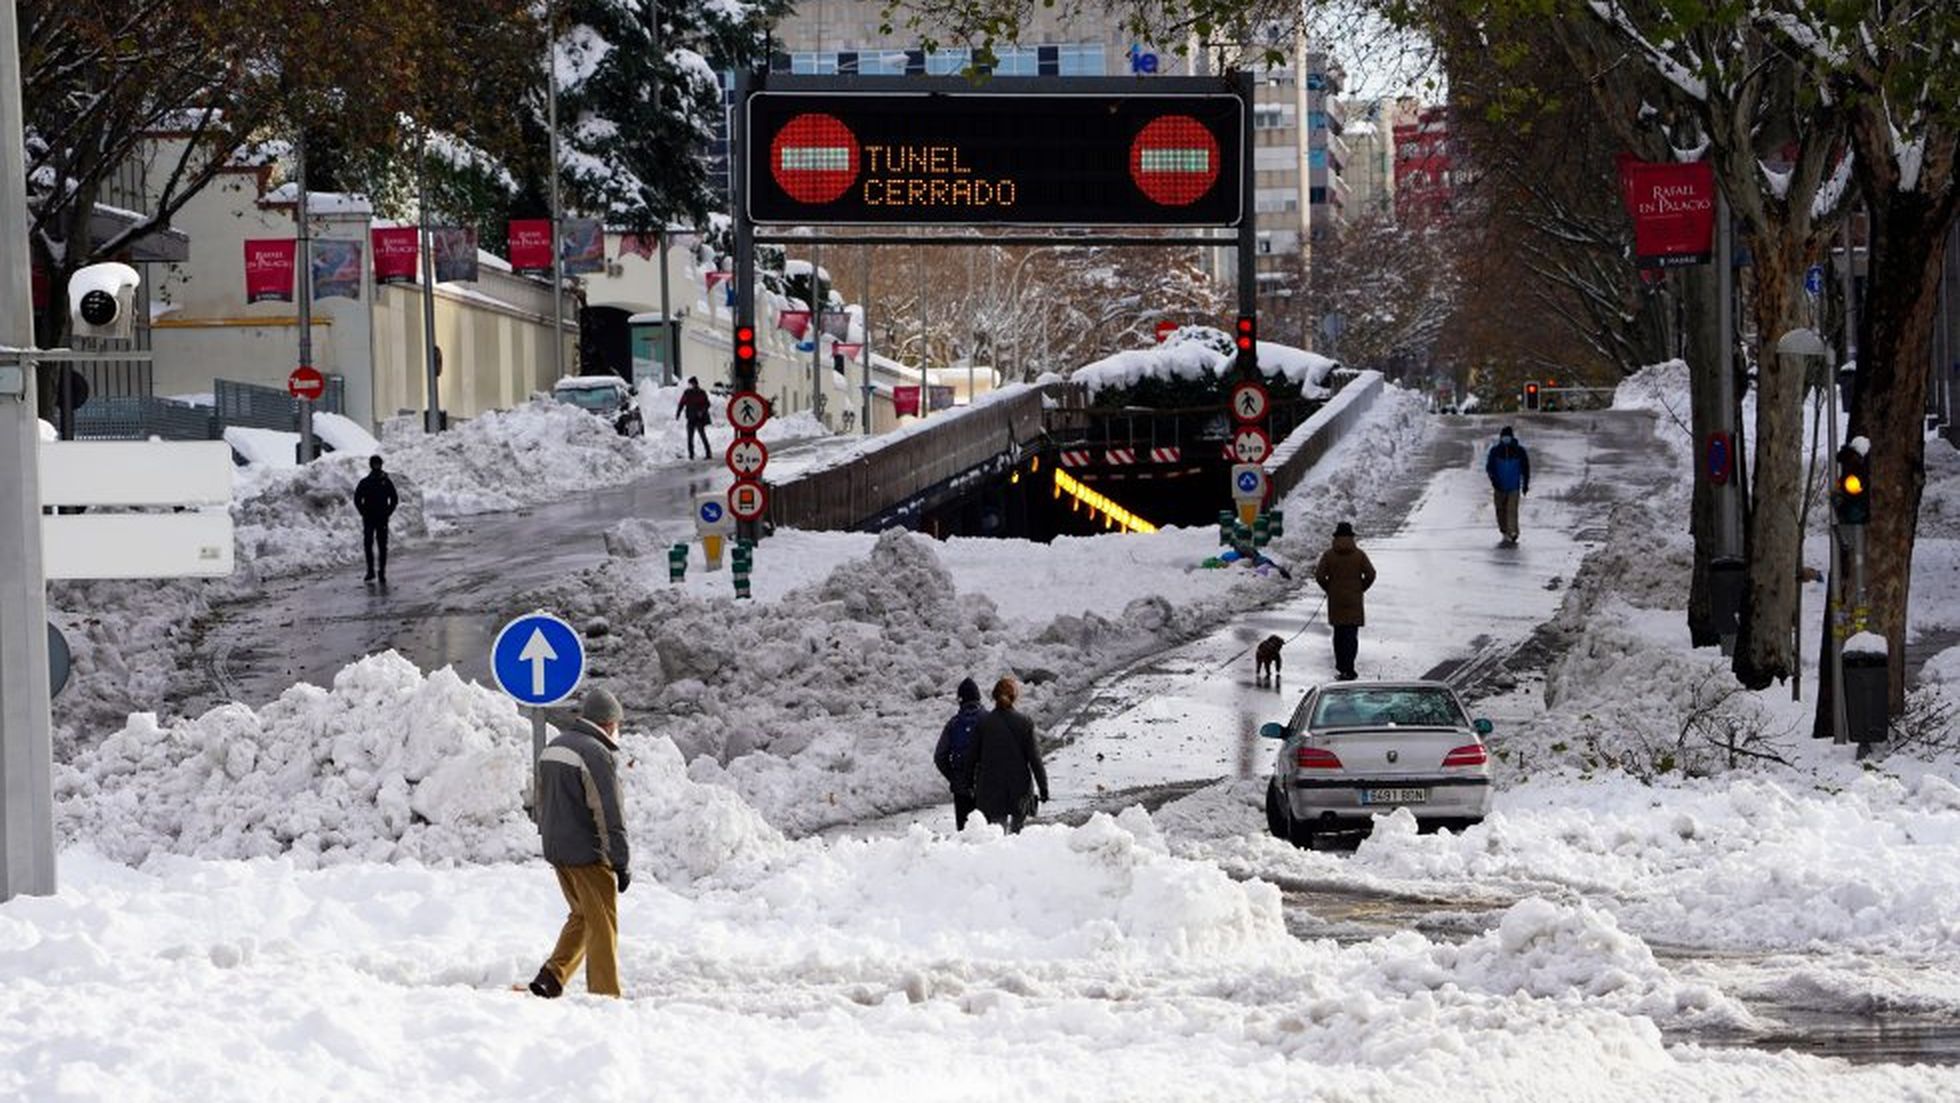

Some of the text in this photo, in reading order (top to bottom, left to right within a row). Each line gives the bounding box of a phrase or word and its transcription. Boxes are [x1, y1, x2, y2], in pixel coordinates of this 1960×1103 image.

[1132, 42, 1158, 73] ie
[865, 146, 971, 173] TUNEL
[864, 179, 1015, 205] CERRADO
